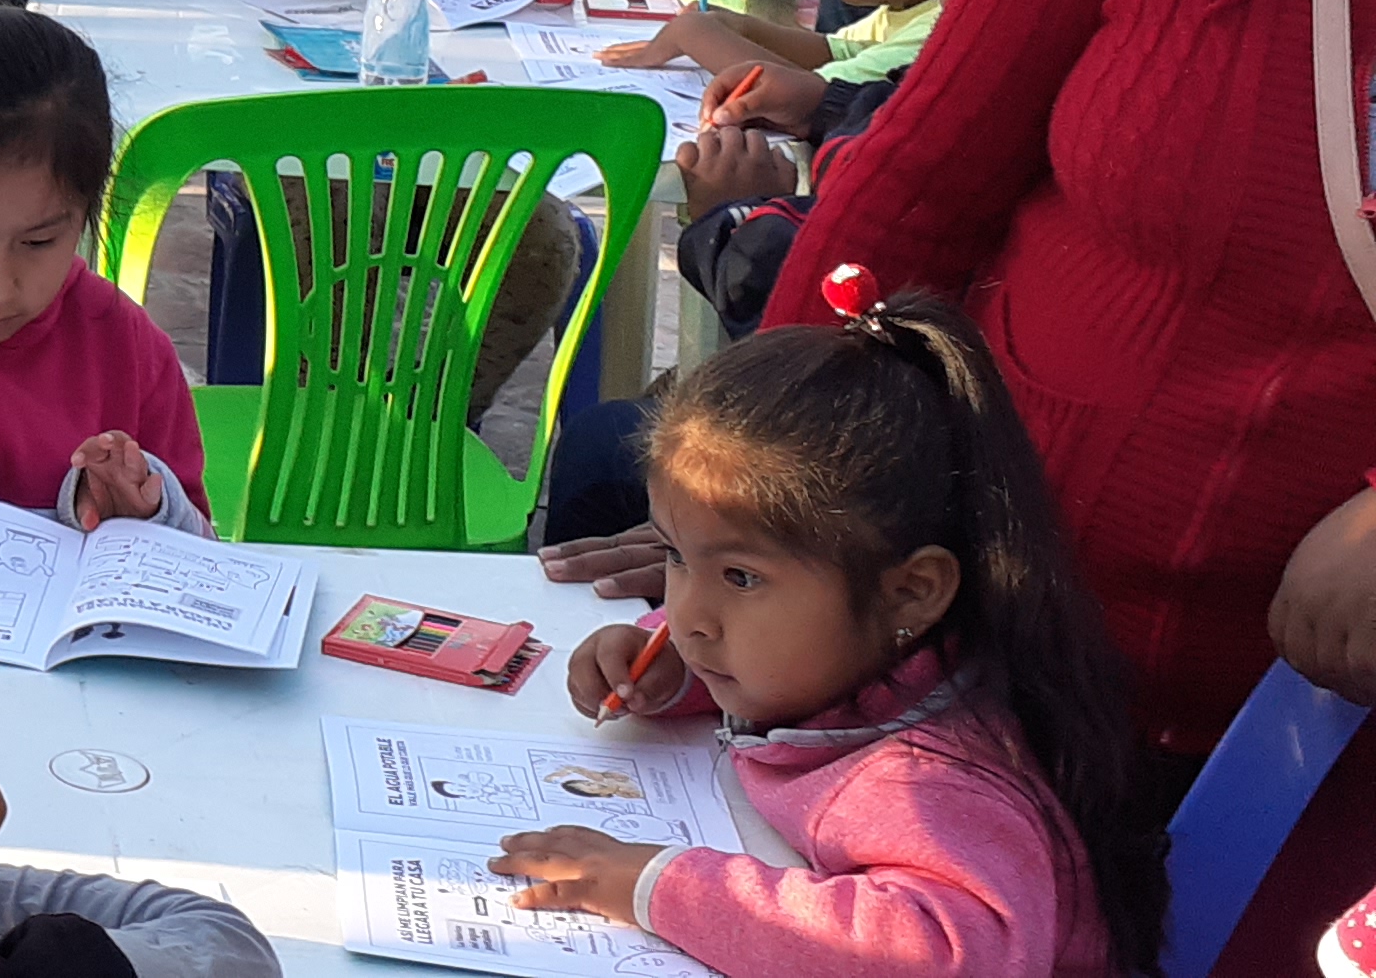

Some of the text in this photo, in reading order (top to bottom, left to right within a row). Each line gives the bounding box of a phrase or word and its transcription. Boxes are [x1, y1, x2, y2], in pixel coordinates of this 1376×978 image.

[376, 737, 404, 806] EL AGUA POTABLE
[391, 859, 406, 882] PARA
[393, 883, 411, 917] LIMPIAN
[407, 859, 433, 945] LLEGAR A TU CASA
[398, 916, 411, 929] ME
